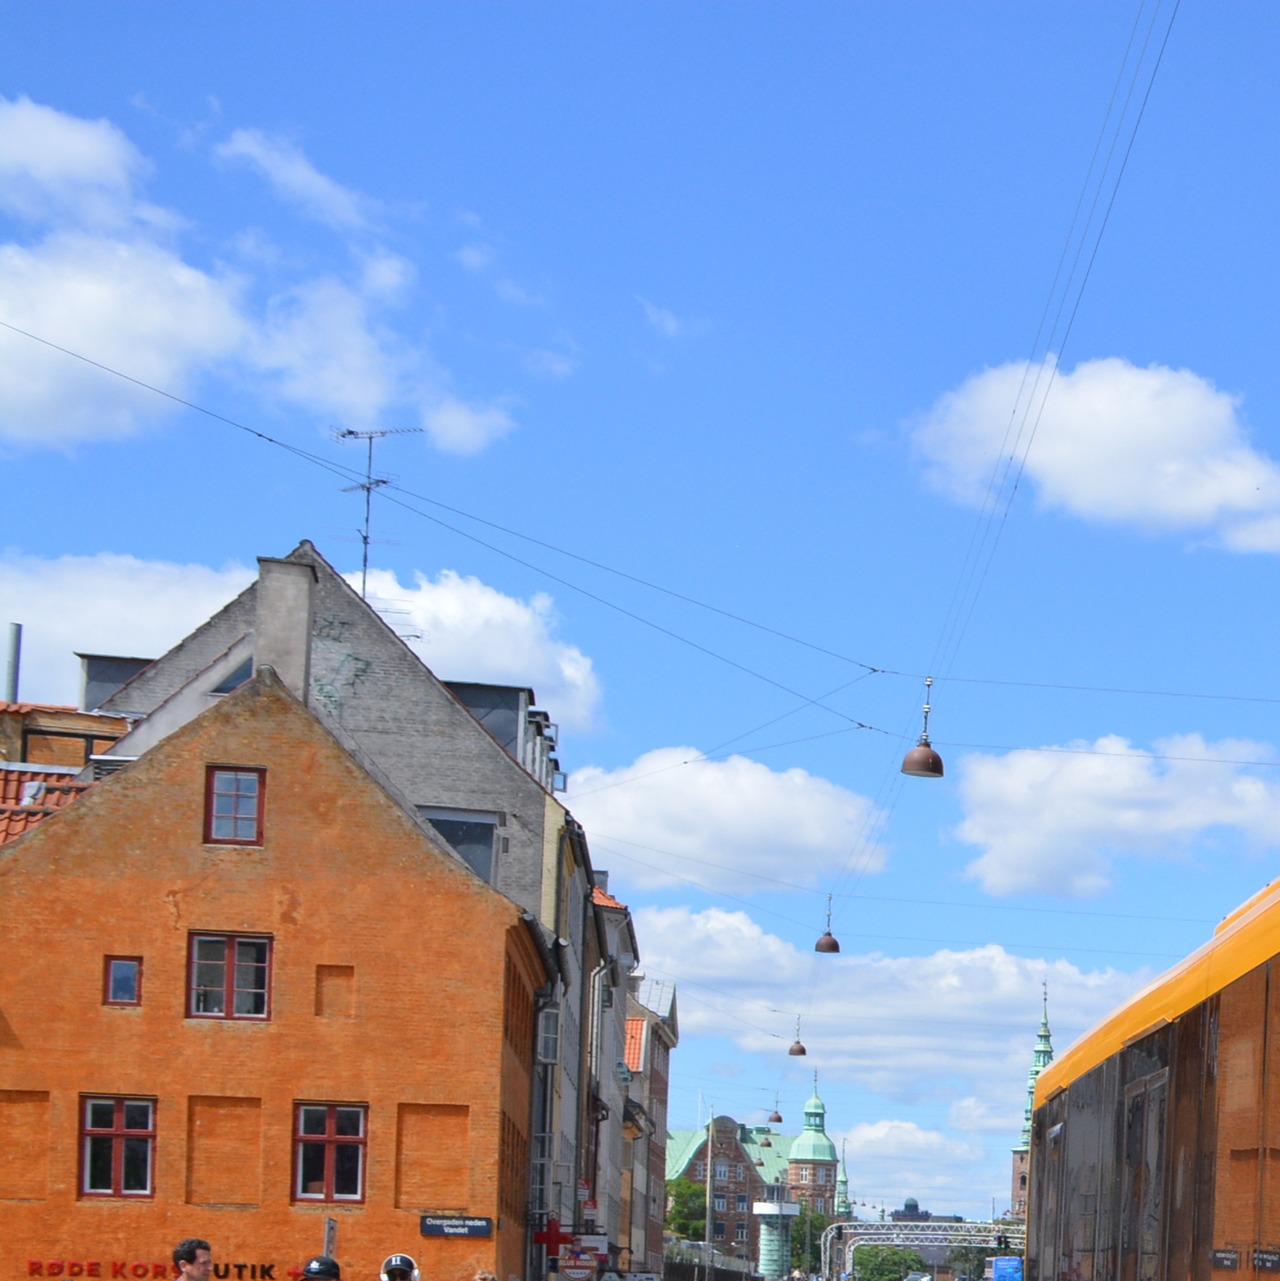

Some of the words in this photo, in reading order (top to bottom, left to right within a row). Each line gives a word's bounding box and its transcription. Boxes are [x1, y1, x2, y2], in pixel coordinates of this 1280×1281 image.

[426, 1218, 463, 1226] Overgaden
[443, 1226, 469, 1234] Vandet
[28, 1259, 100, 1277] RØDE
[212, 1263, 275, 1280] UTIK
